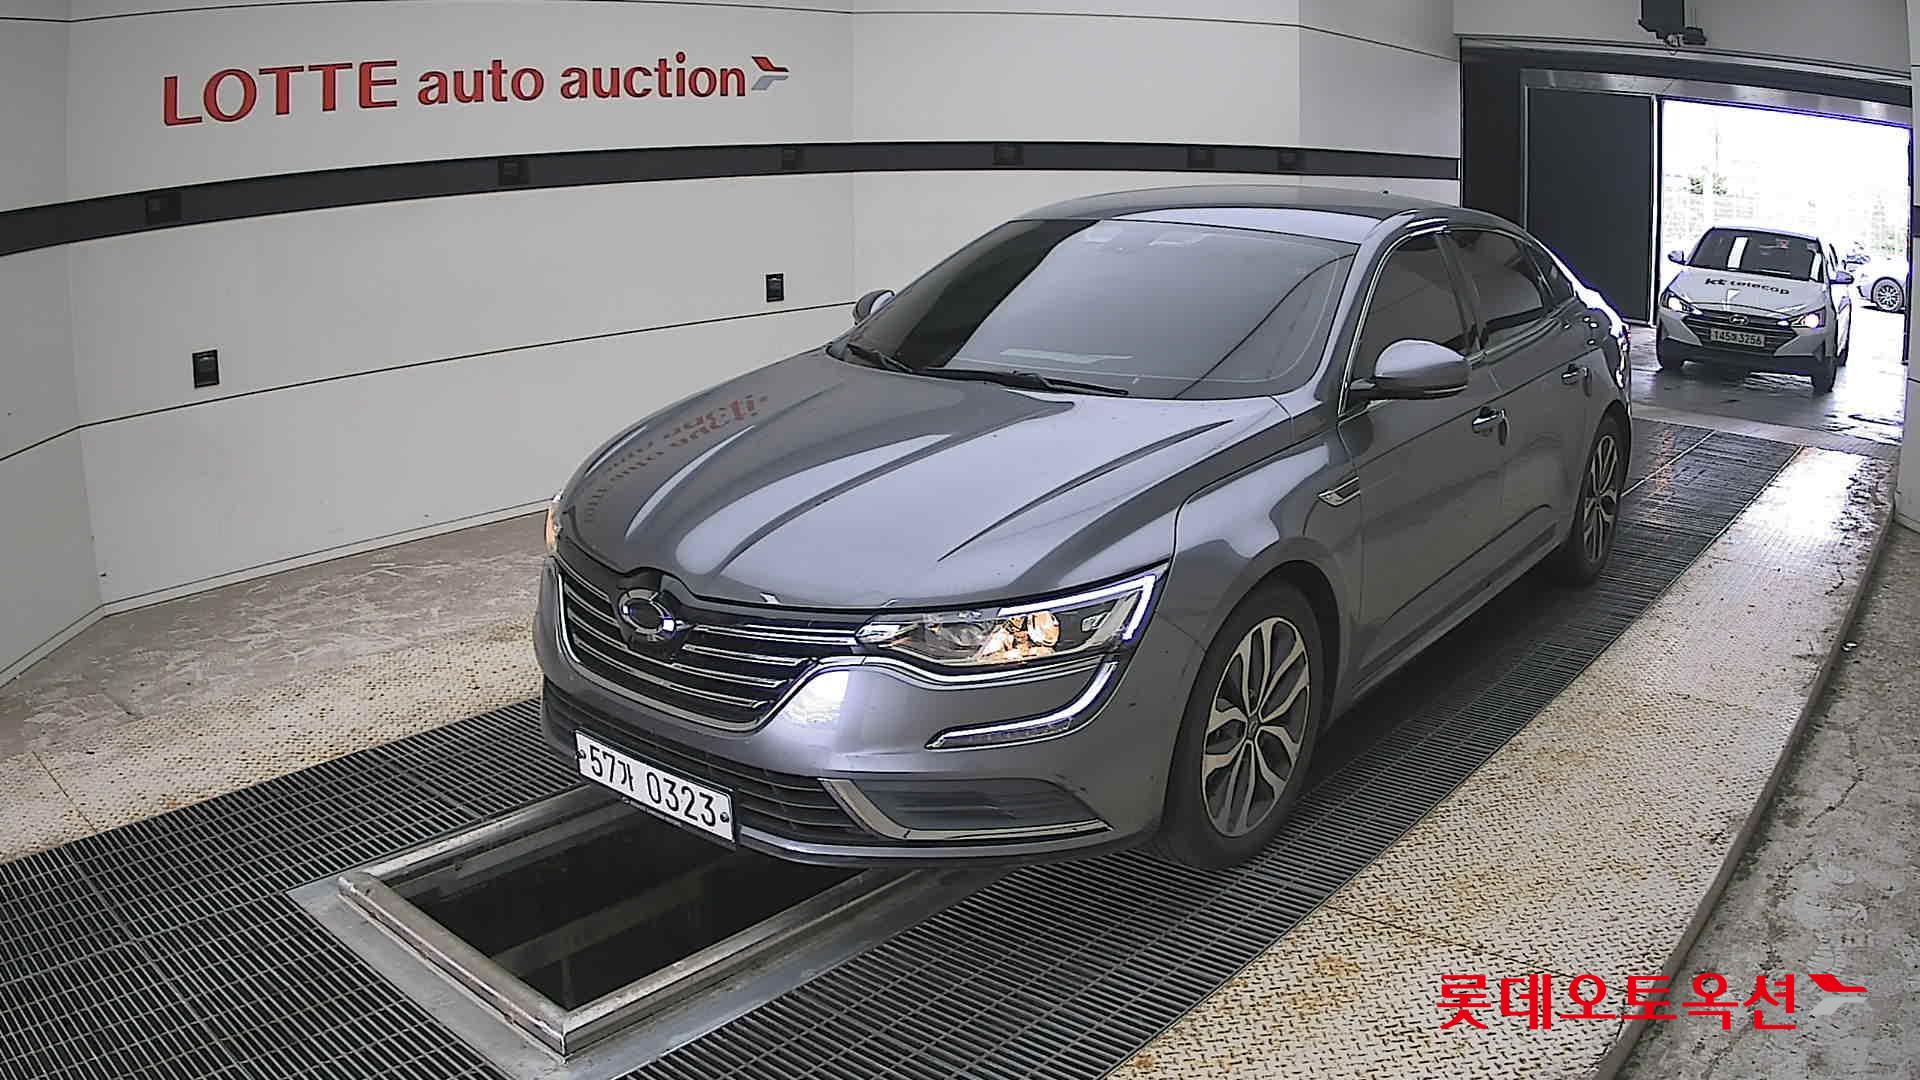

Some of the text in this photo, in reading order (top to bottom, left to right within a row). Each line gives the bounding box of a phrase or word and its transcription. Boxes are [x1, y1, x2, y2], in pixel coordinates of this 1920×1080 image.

[162, 52, 747, 127] LOTTE auto auction
[589, 744, 716, 827] 57가 0323
